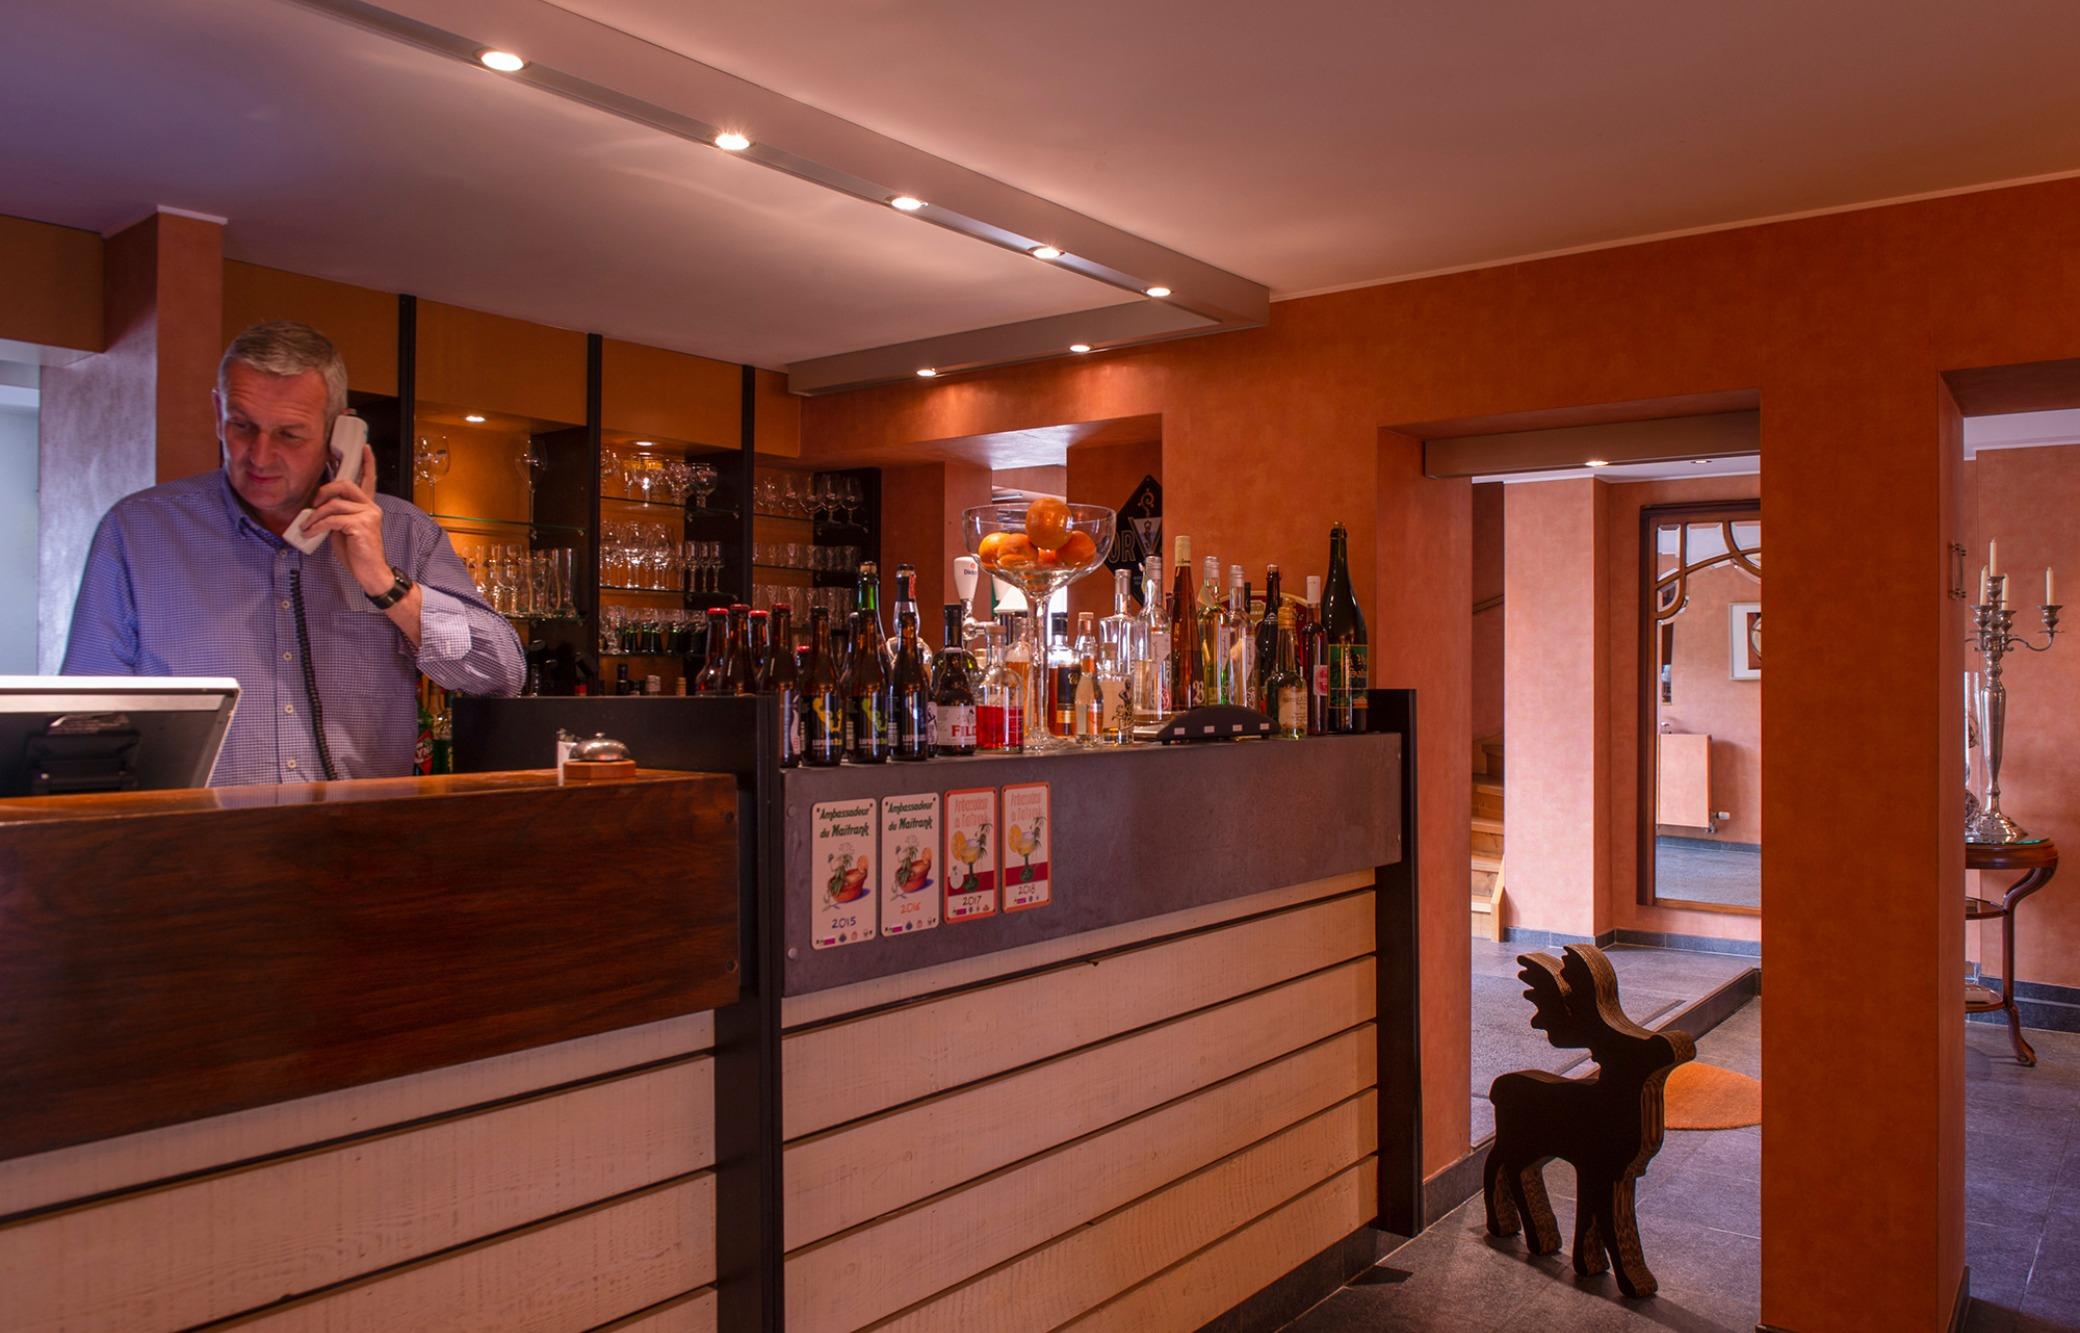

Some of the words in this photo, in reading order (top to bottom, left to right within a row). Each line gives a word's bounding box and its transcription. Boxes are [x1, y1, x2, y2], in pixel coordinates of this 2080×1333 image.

[819, 806, 870, 821] Ambassadeur
[888, 800, 933, 814] Ambassadeur
[962, 895, 982, 906] 2017
[832, 916, 857, 929] 2015
